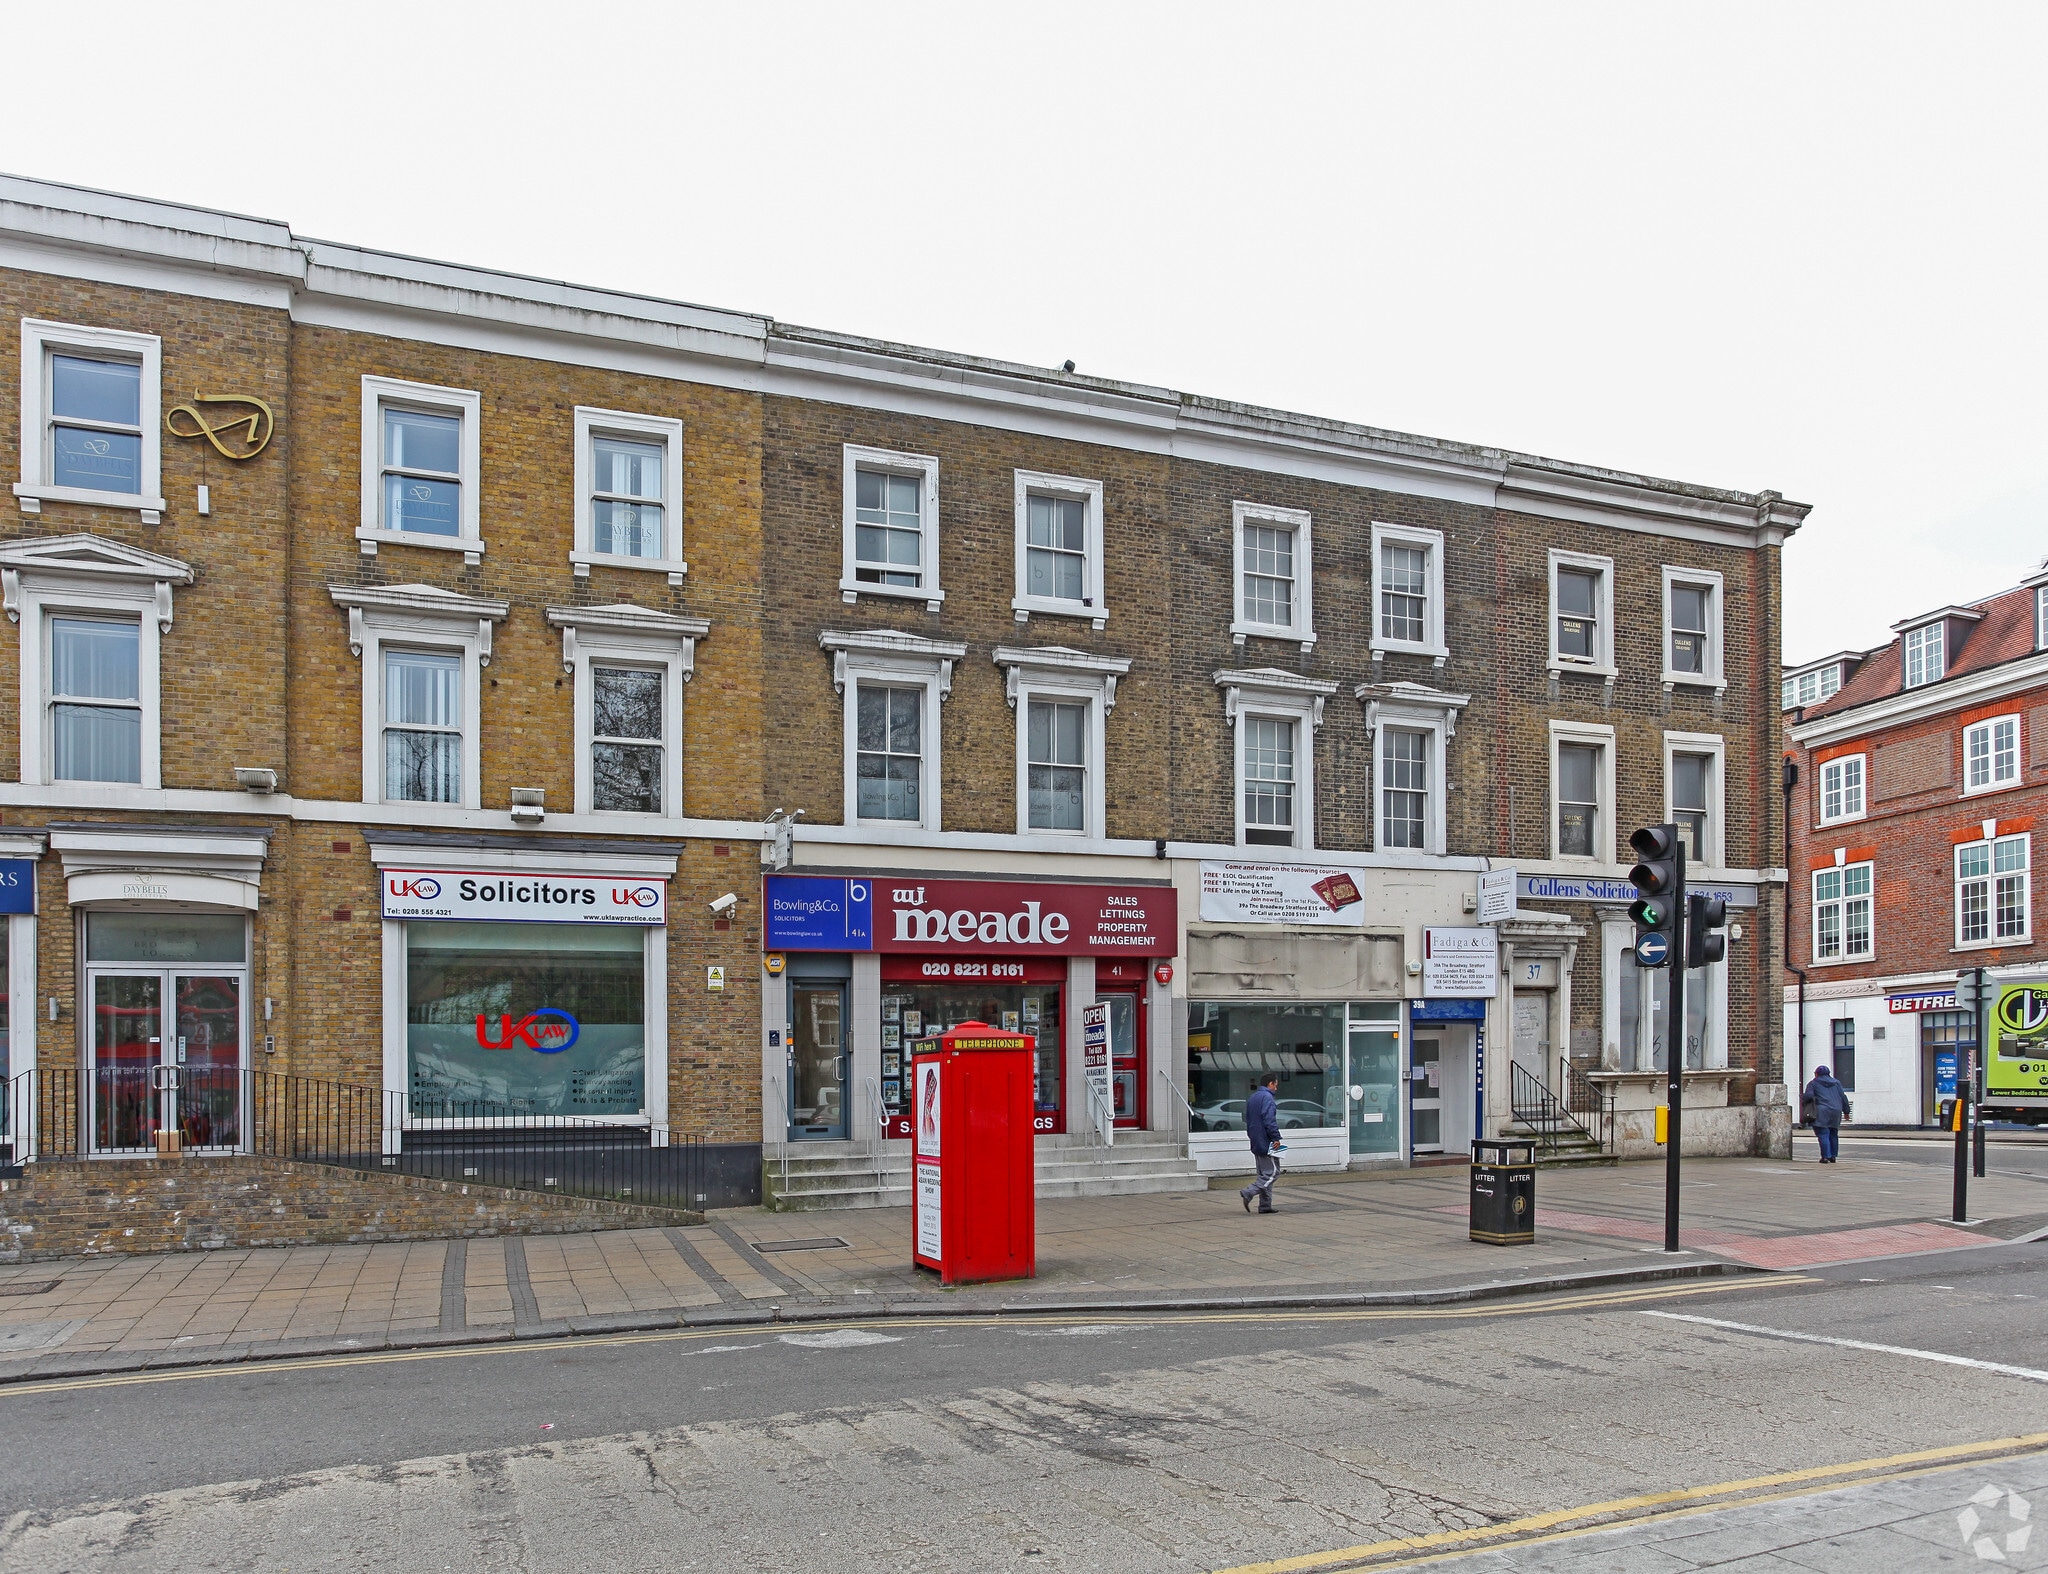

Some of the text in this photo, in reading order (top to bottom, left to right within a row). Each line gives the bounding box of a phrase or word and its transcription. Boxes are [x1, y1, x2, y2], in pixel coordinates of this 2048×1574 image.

[1291, 866, 1318, 874] following
[123, 885, 168, 894] DAYBELLS
[390, 880, 436, 900] UK LAW
[460, 880, 596, 905] Solicitors
[850, 879, 866, 902] b
[1528, 877, 1580, 898] Cullens
[1586, 880, 1638, 900] Solicitor
[1714, 892, 1732, 902] 1653
[612, 888, 654, 906] UK LAW
[1108, 896, 1138, 906] SALES
[774, 899, 840, 914] Bowling&Co.
[583, 914, 662, 922] www.uklawpractice.com
[1100, 910, 1145, 920] LETTINGS
[892, 901, 1070, 944] meade
[1098, 922, 1148, 932] PROPERTY
[1089, 936, 1156, 946] MANAGEMENT
[1433, 936, 1494, 949] Fadiga & Co
[922, 963, 1024, 976] 020 8221 8161
[1112, 966, 1122, 976] 41
[1527, 964, 1541, 980] 37
[1413, 1001, 1425, 1009] 39A
[1084, 1008, 1105, 1024] OPEN
[476, 1014, 570, 1050] UK LAW
[1085, 1028, 1104, 1042] meade
[960, 1040, 1020, 1048] TELEPHONE
[1086, 1068, 1107, 1076] MANAGEMENT
[2033, 1064, 2047, 1072] 01
[1475, 1174, 1495, 1182] LITTER
